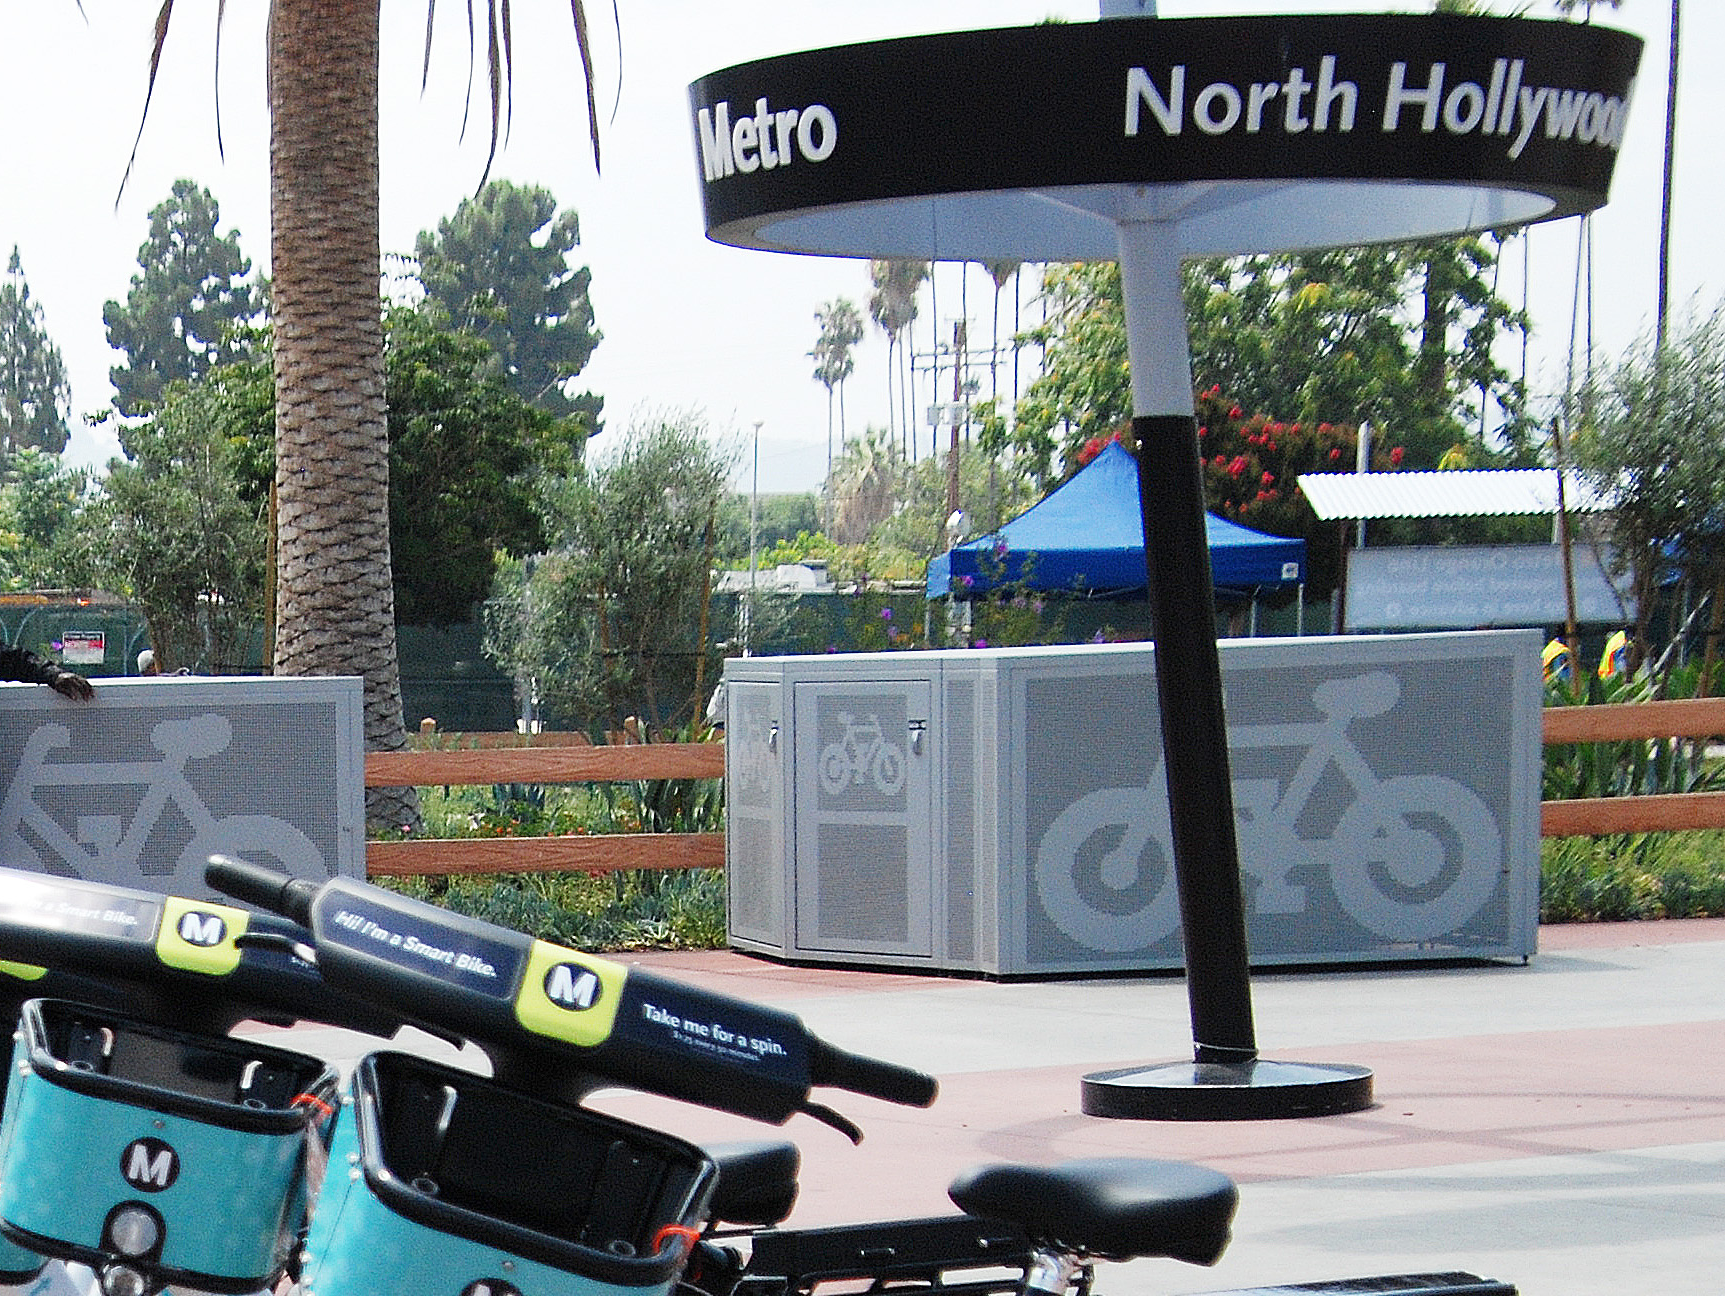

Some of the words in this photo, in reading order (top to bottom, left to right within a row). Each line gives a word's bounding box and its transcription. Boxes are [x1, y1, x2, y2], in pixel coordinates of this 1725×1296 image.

[1124, 54, 1358, 136] North
[697, 97, 838, 182] Metro
[103, 910, 138, 925] Bike.
[334, 910, 365, 931] Hi!
[360, 921, 389, 941] I'm
[389, 933, 403, 947] a
[403, 936, 456, 964] Smart
[455, 953, 498, 978] Bike.
[642, 1003, 681, 1028] Take
[684, 1019, 710, 1037] me
[712, 1024, 735, 1043] for
[737, 1035, 747, 1047] a
[750, 1037, 788, 1056] spin.
